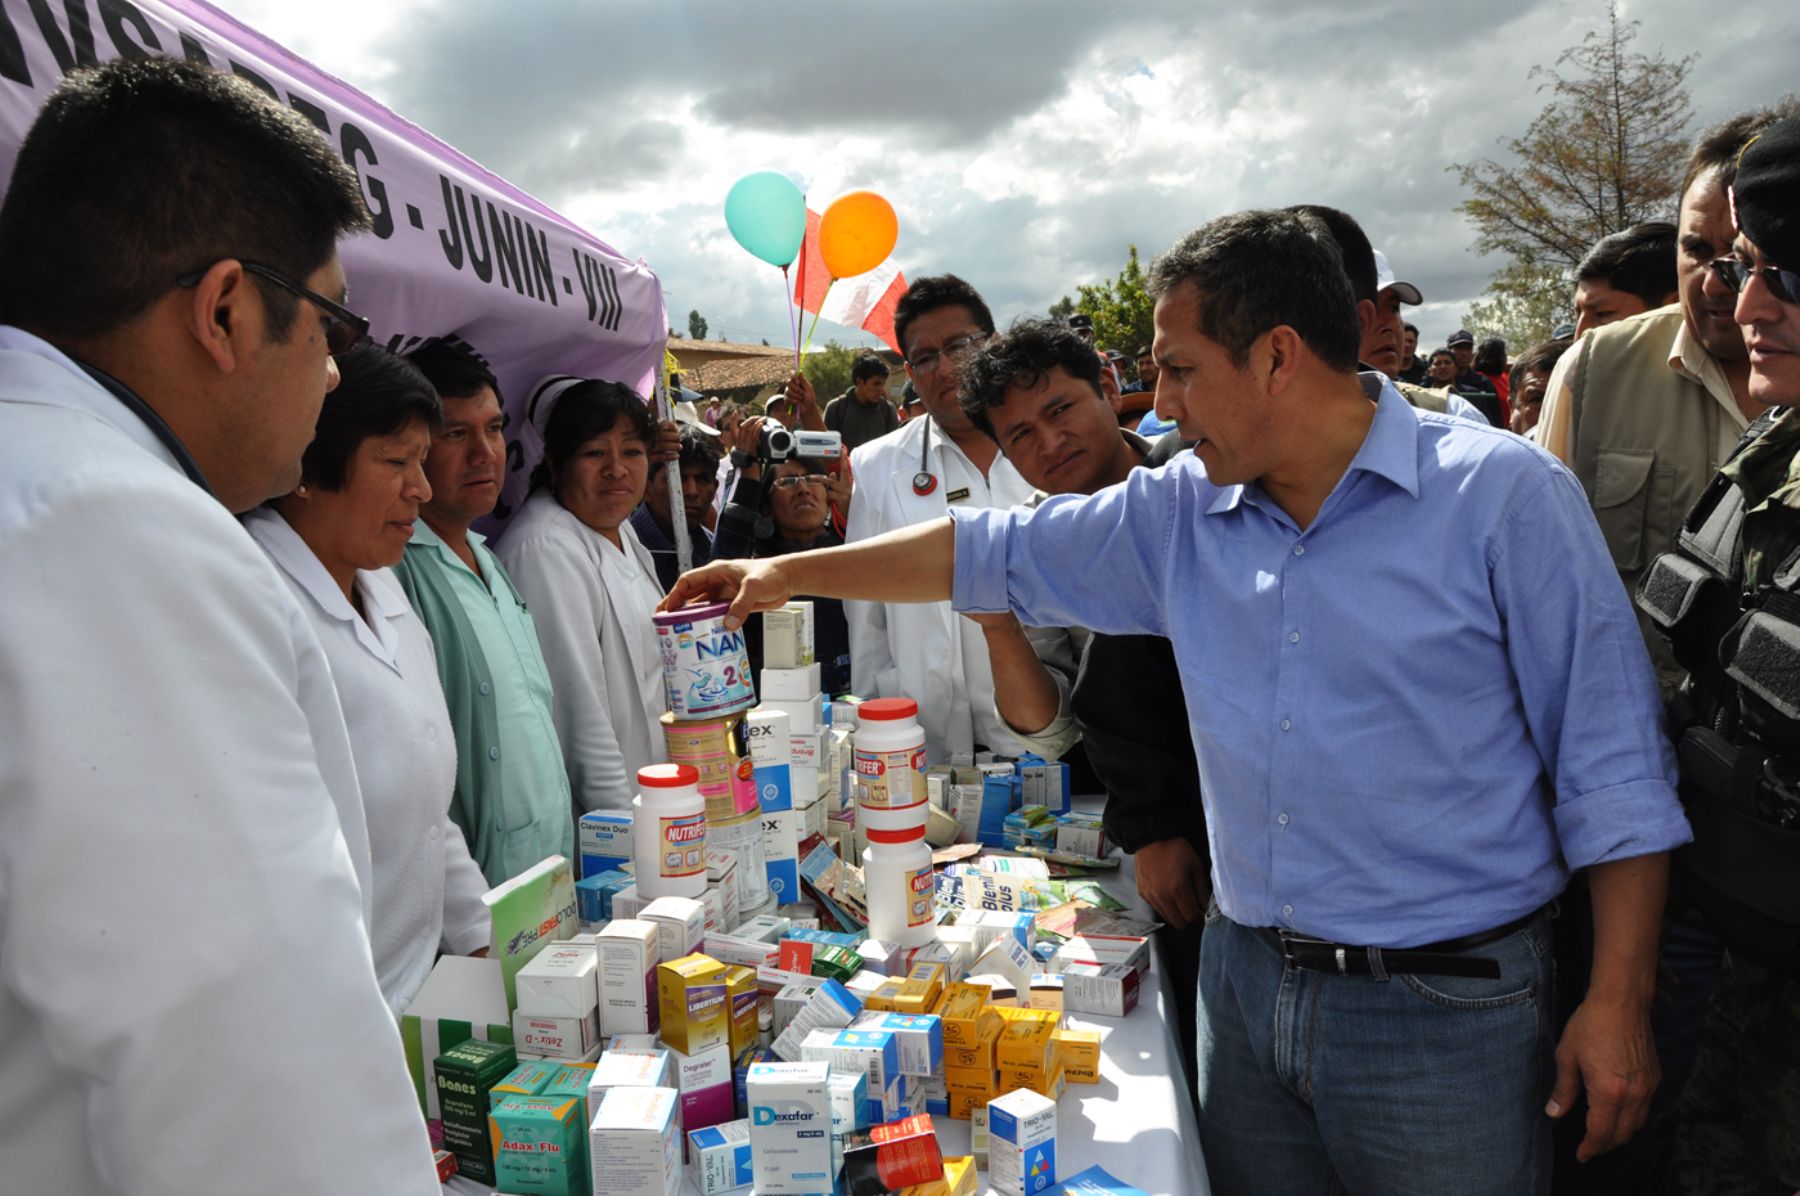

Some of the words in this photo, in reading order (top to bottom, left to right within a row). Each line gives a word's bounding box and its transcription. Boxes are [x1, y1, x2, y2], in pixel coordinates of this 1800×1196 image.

[438, 174, 558, 307] JUNIN
[572, 247, 622, 332] VIII
[723, 665, 738, 687] 2
[749, 725, 774, 737] ex
[580, 822, 611, 832] Clavinex
[612, 825, 629, 834] Duo
[667, 823, 706, 842] NUTRIFE
[980, 874, 998, 911] Blemil
[438, 1075, 476, 1095] Banes
[752, 1105, 815, 1127] Dexafar
[502, 1139, 535, 1152] Adax
[540, 1141, 561, 1153] Flu
